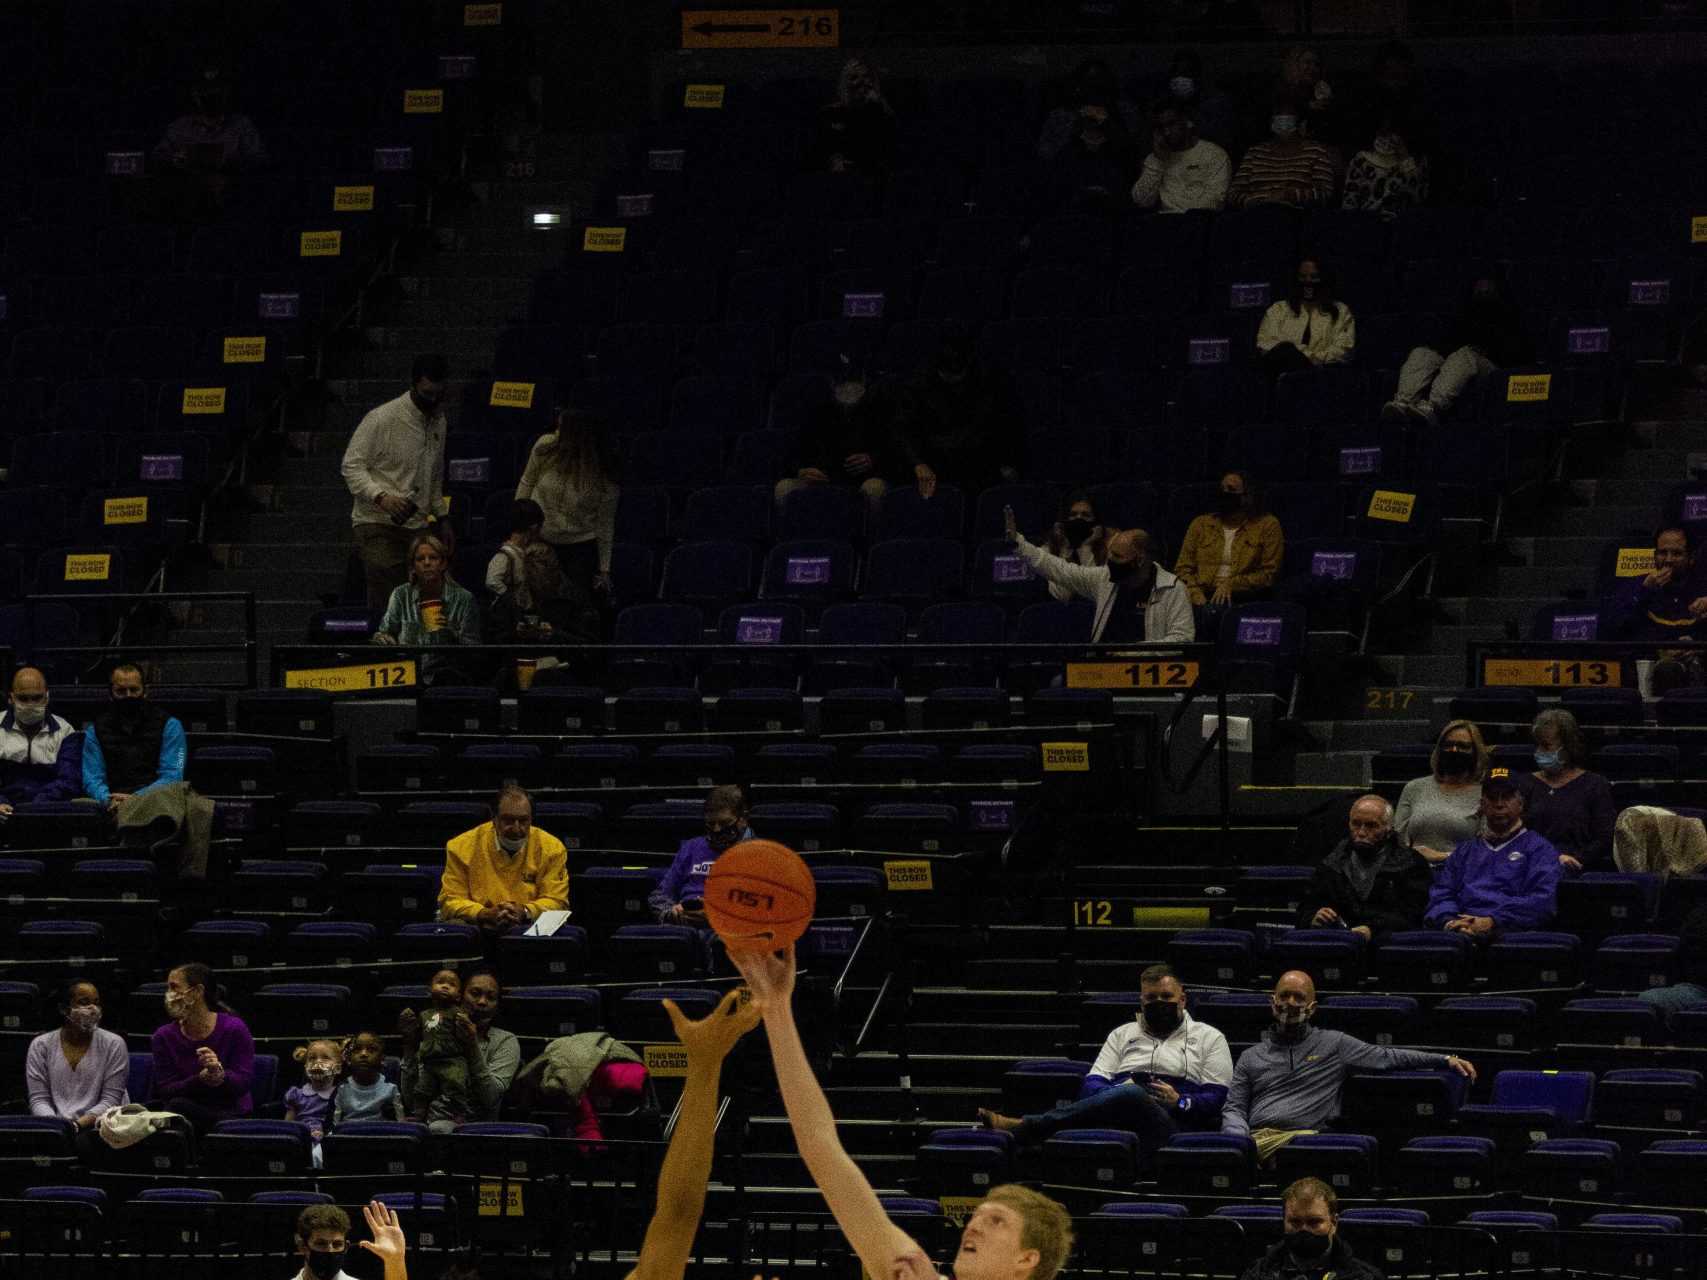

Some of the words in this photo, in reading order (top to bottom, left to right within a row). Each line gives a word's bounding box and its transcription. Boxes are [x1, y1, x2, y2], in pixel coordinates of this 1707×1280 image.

[778, 16, 832, 36] 216
[1511, 386, 1546, 395] CLOSED
[107, 509, 143, 518] CLOSED
[1373, 503, 1409, 515] CLOSED
[69, 566, 105, 574] CLOSED
[297, 676, 346, 689] SECTION
[366, 666, 406, 688] 112
[1125, 663, 1187, 686] 112
[1544, 662, 1609, 685] 113
[1367, 688, 1414, 710] 217
[1047, 755, 1084, 763] CLOSED
[889, 874, 928, 882] CLOSED
[648, 1060, 688, 1068] CLOSED
